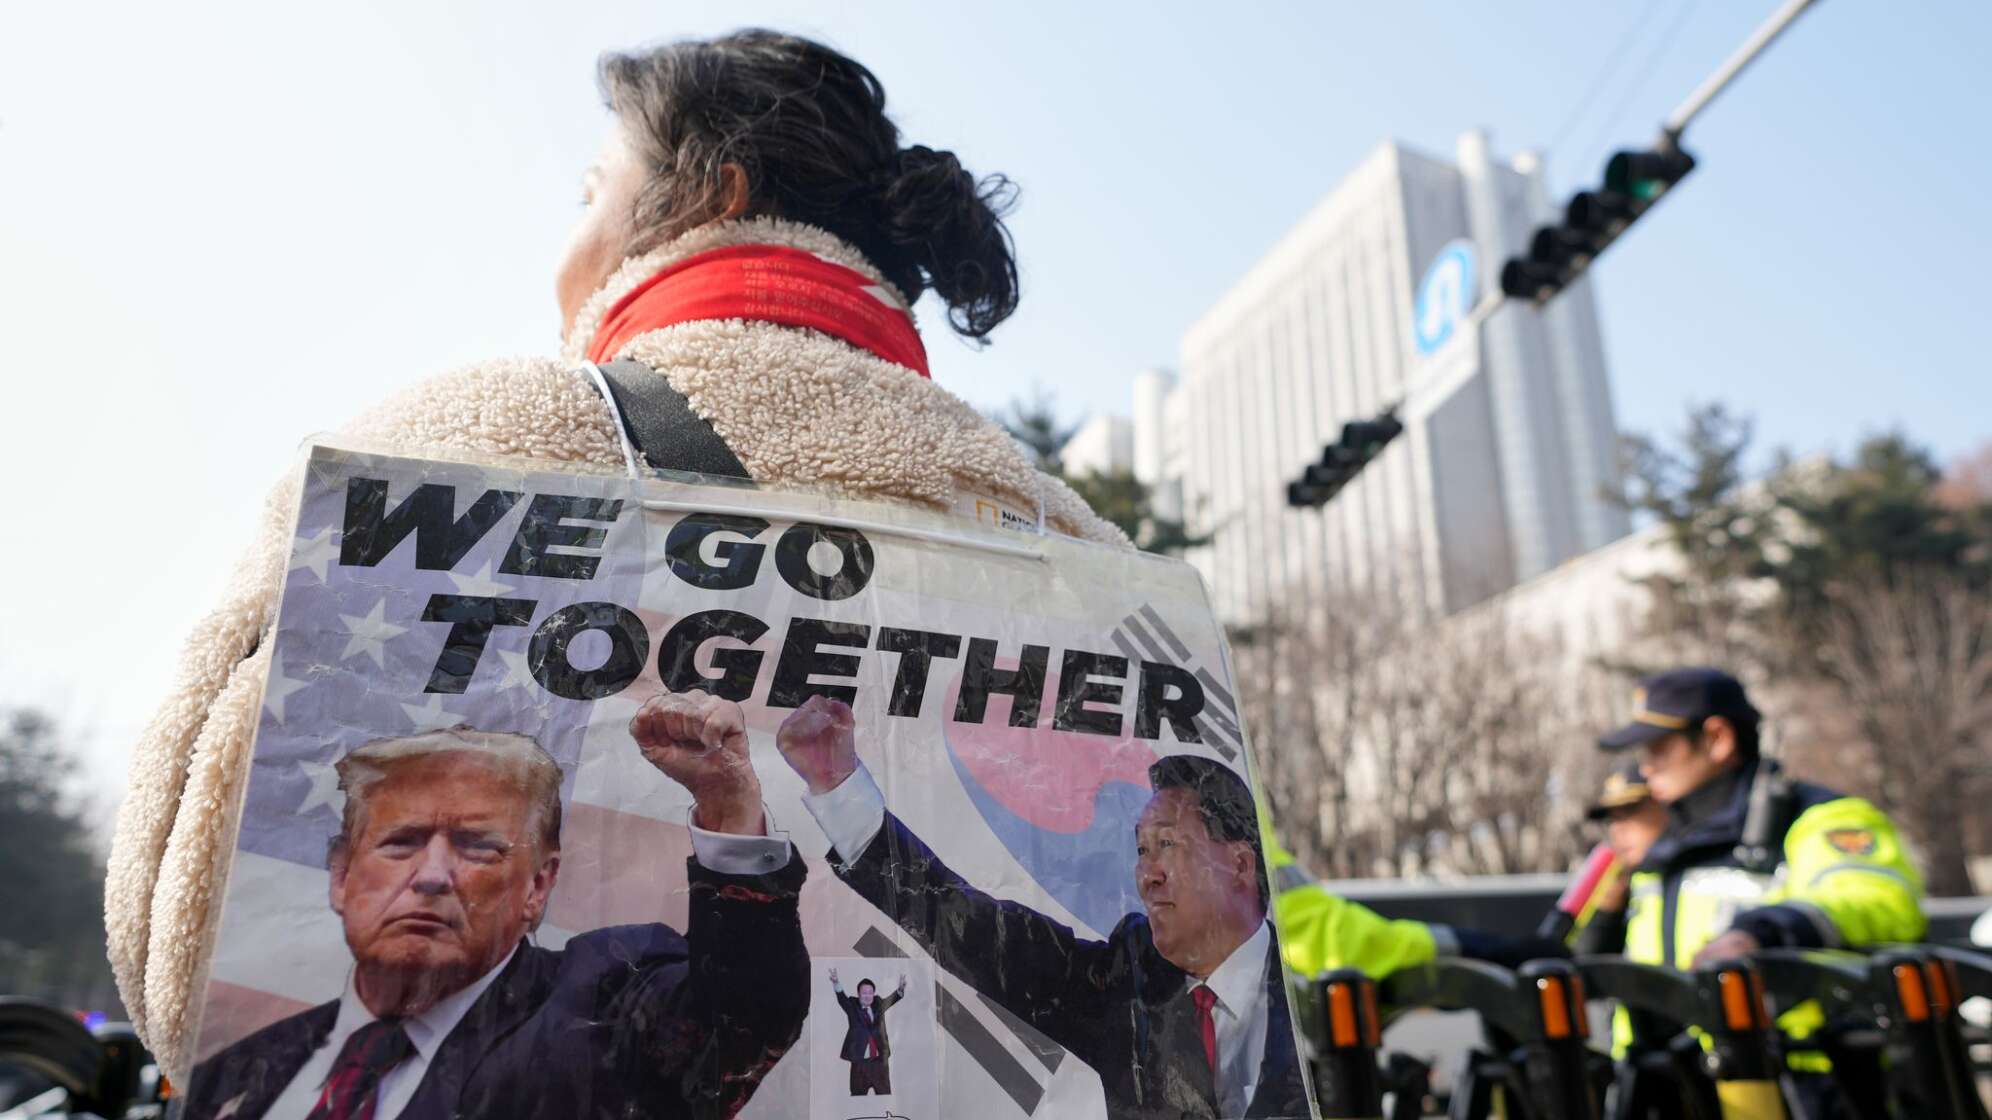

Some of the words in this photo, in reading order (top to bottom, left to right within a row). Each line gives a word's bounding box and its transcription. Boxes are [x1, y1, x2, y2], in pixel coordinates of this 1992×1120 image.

[339, 477, 623, 581] WE
[664, 511, 876, 602] GO
[422, 594, 1207, 743] TOGETHER
